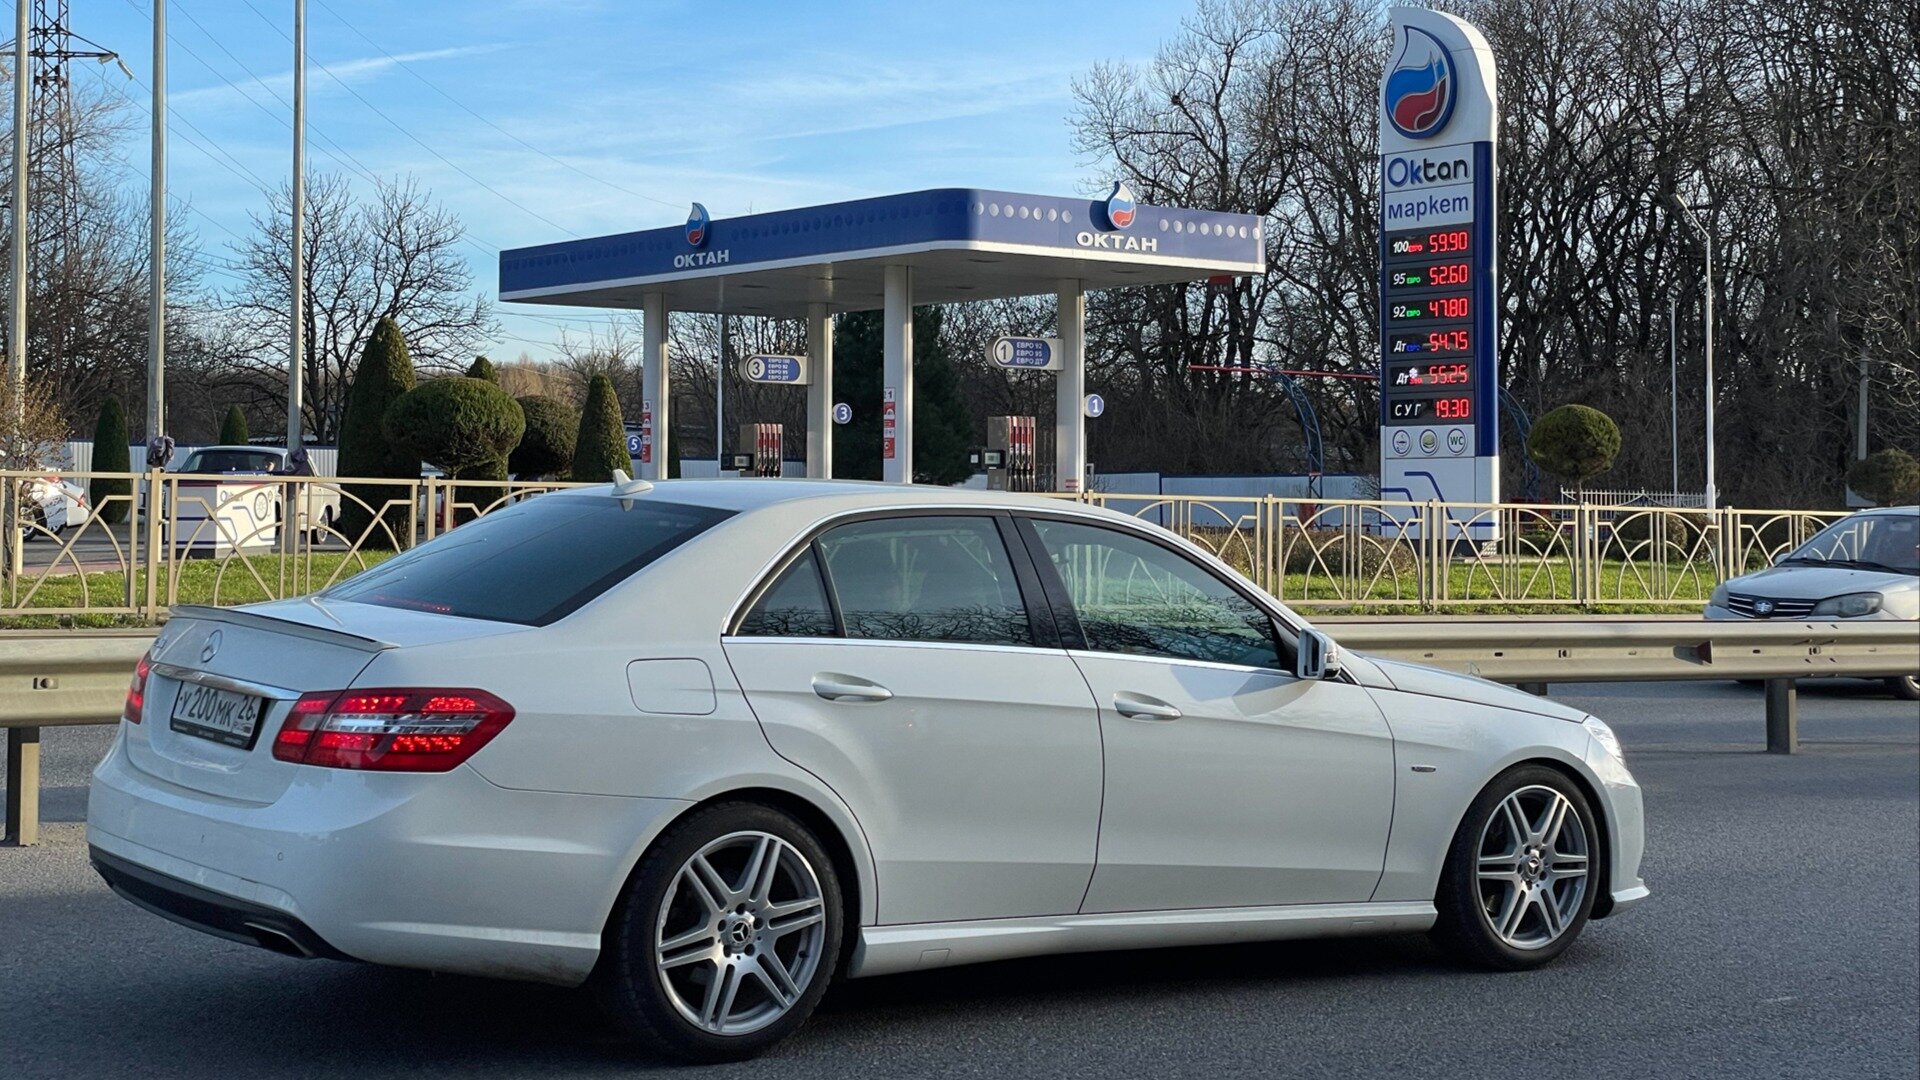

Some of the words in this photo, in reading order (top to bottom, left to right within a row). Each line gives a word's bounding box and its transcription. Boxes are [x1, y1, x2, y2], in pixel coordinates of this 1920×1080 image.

[1387, 157, 1468, 187] Oktan
[1076, 231, 1158, 252] ОКТАН
[1393, 240, 1409, 253] 100
[1429, 231, 1468, 253] 59.90
[673, 249, 729, 268] ОКТАН
[1393, 272, 1406, 285] 95
[1429, 264, 1468, 285] 52.60
[1393, 305, 1406, 318] 92
[1429, 298, 1468, 317] 47.80
[1429, 331, 1468, 352] 54.75
[1000, 343, 1007, 360] 1
[1016, 349, 1034, 357] ЕВРО
[752, 361, 761, 376] 3
[1429, 364, 1468, 384] 55.25
[839, 407, 848, 420] 3
[1092, 399, 1099, 413] 1
[1435, 399, 1469, 418] 19.30
[630, 438, 638, 451] 5
[1450, 436, 1465, 446] WC
